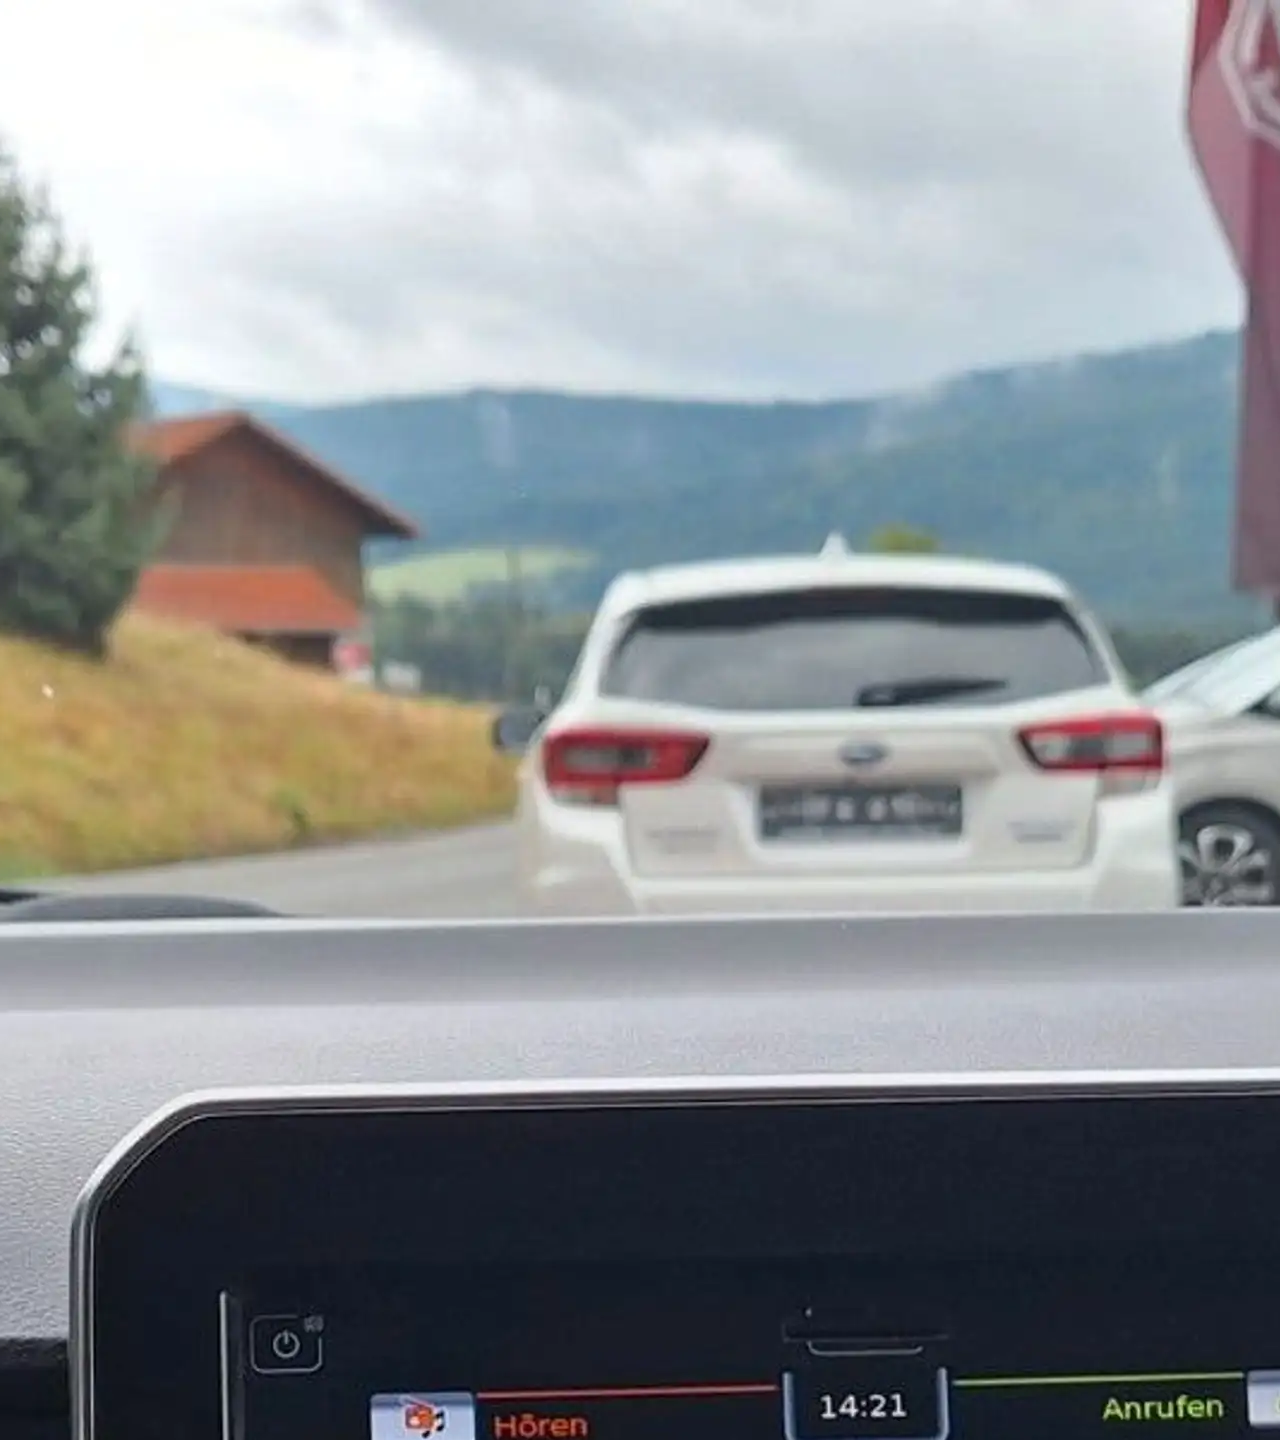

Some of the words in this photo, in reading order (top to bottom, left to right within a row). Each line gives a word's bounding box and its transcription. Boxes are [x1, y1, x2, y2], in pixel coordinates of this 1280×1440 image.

[822, 1394, 906, 1418] 14:21
[1103, 1395, 1223, 1419] Anrufen
[495, 1414, 587, 1437] Hören
